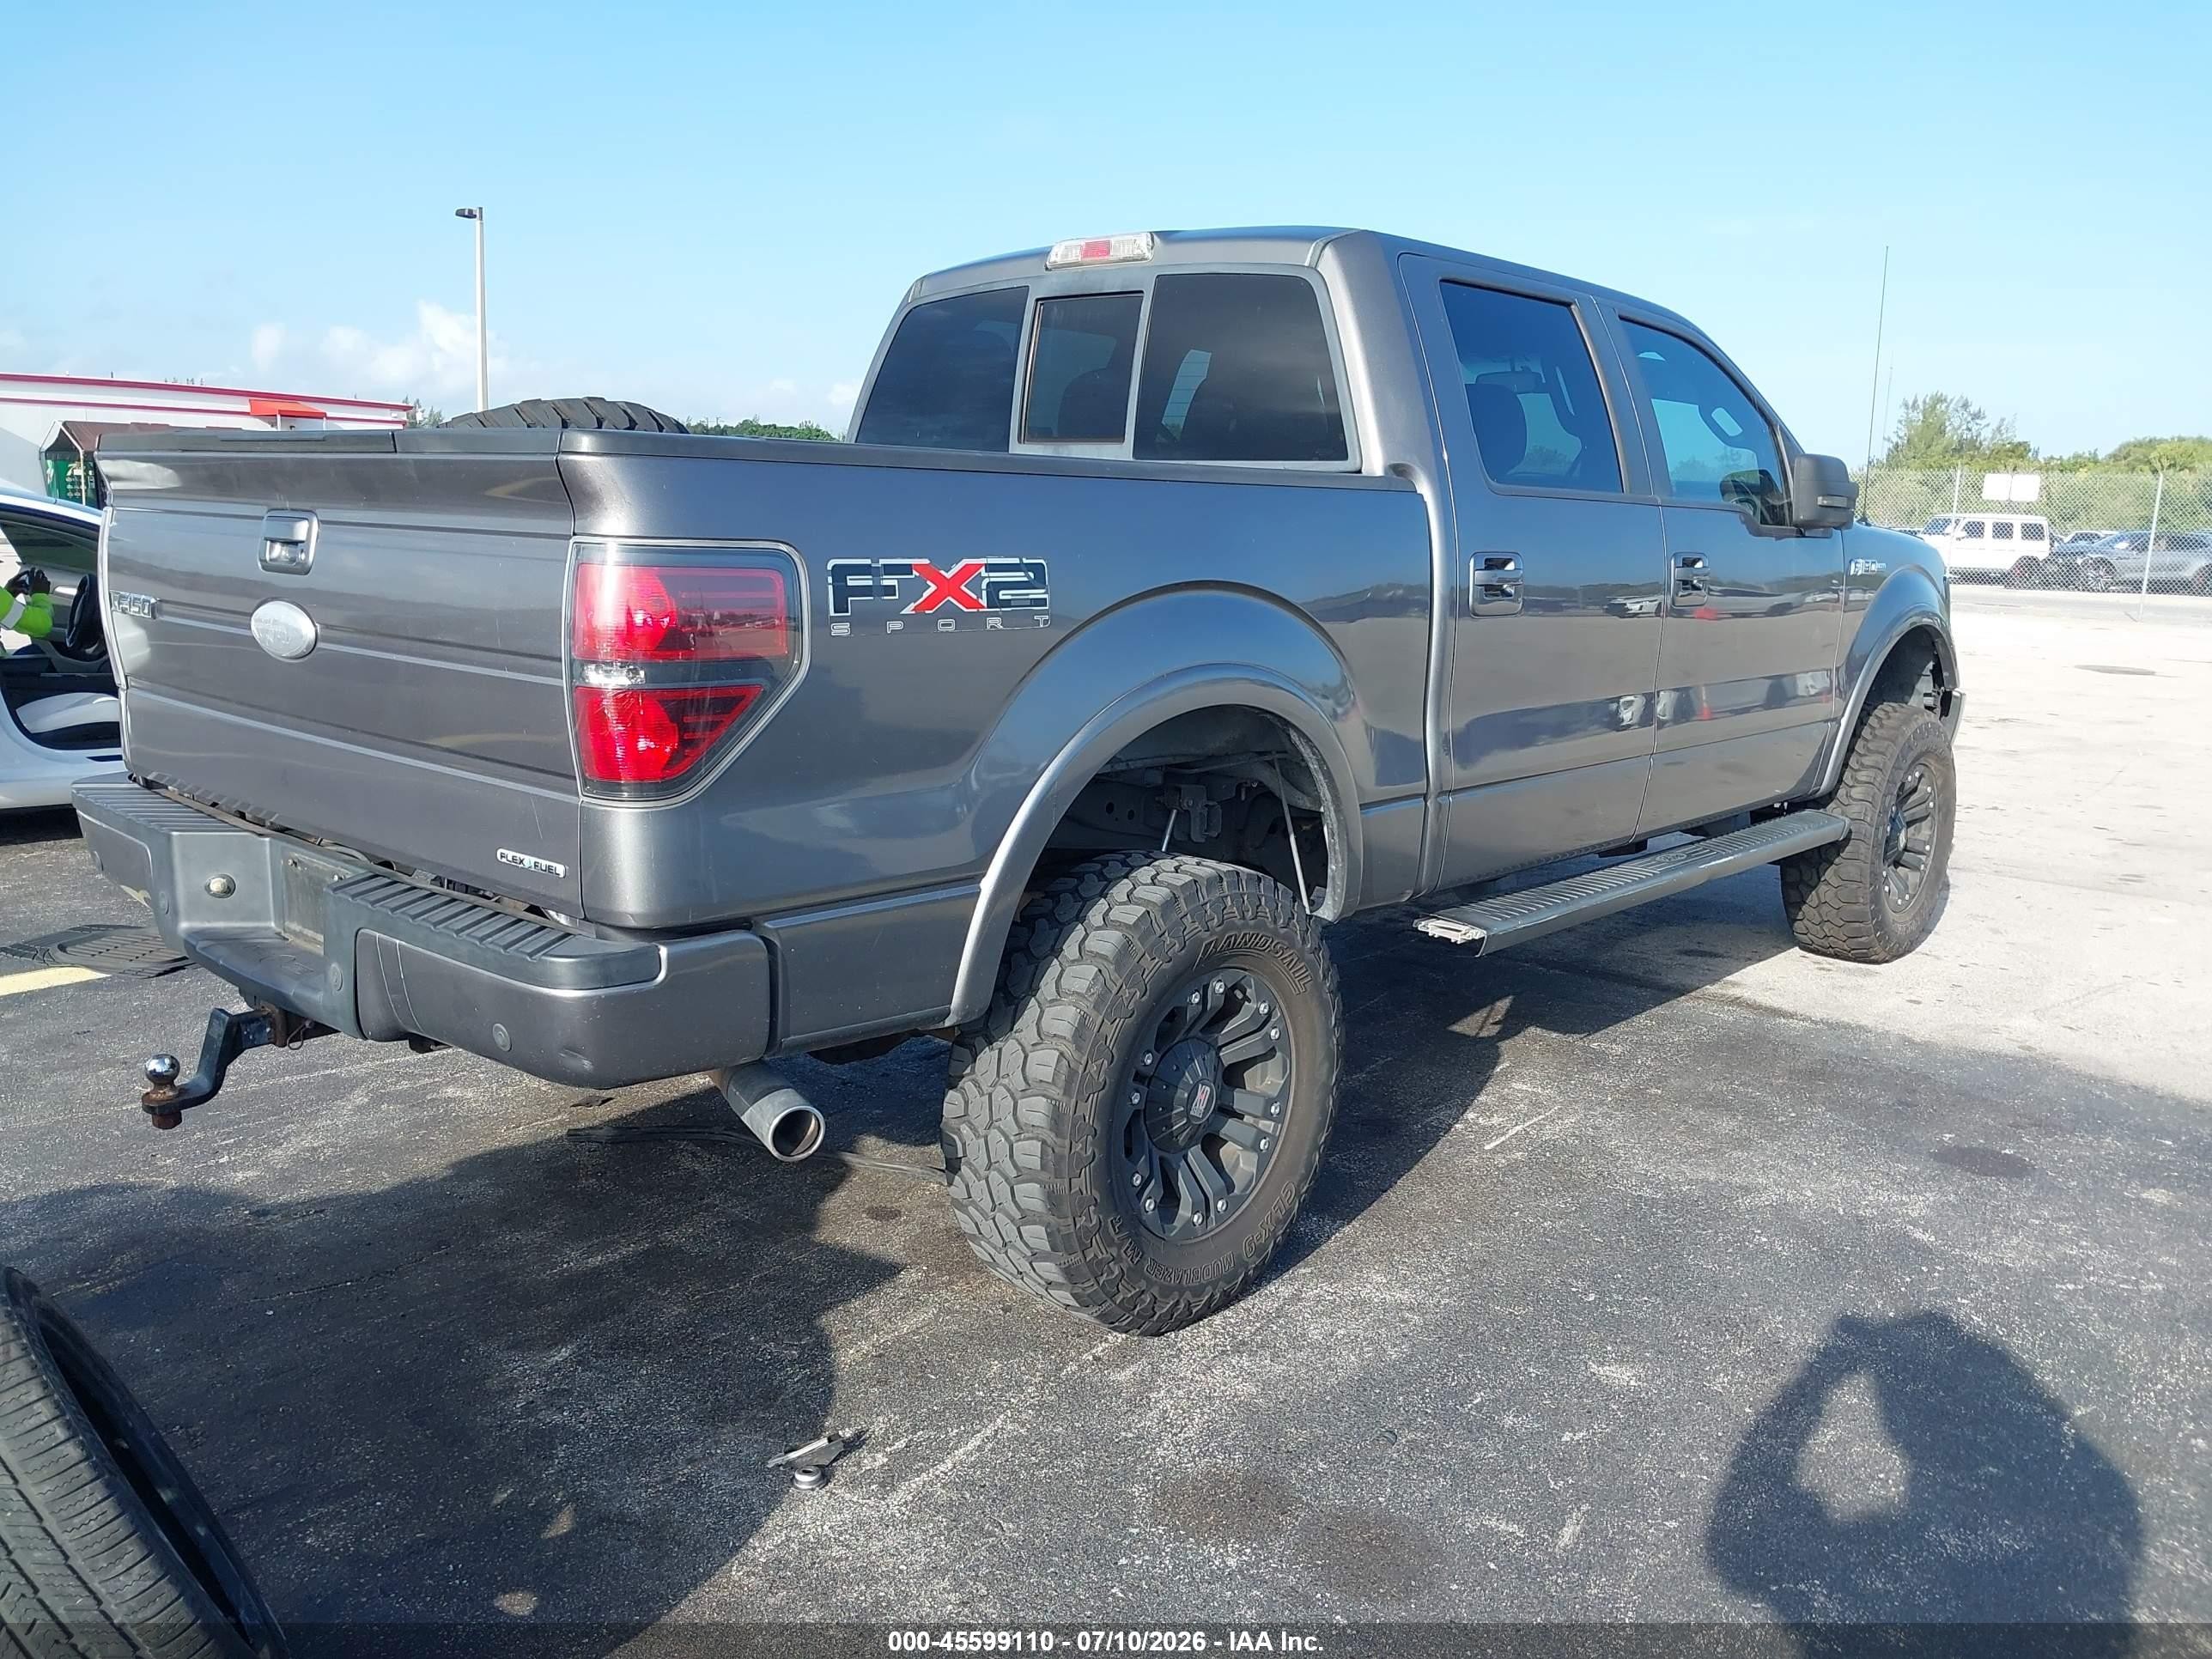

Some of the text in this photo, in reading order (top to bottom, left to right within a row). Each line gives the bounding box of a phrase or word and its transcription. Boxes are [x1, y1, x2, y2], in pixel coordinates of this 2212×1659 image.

[826, 556, 1050, 617] FX2
[830, 615, 1049, 636] SPORT
[500, 851, 561, 876] FLEX FUEL
[1145, 1251, 1237, 1285] MUDBLAZER
